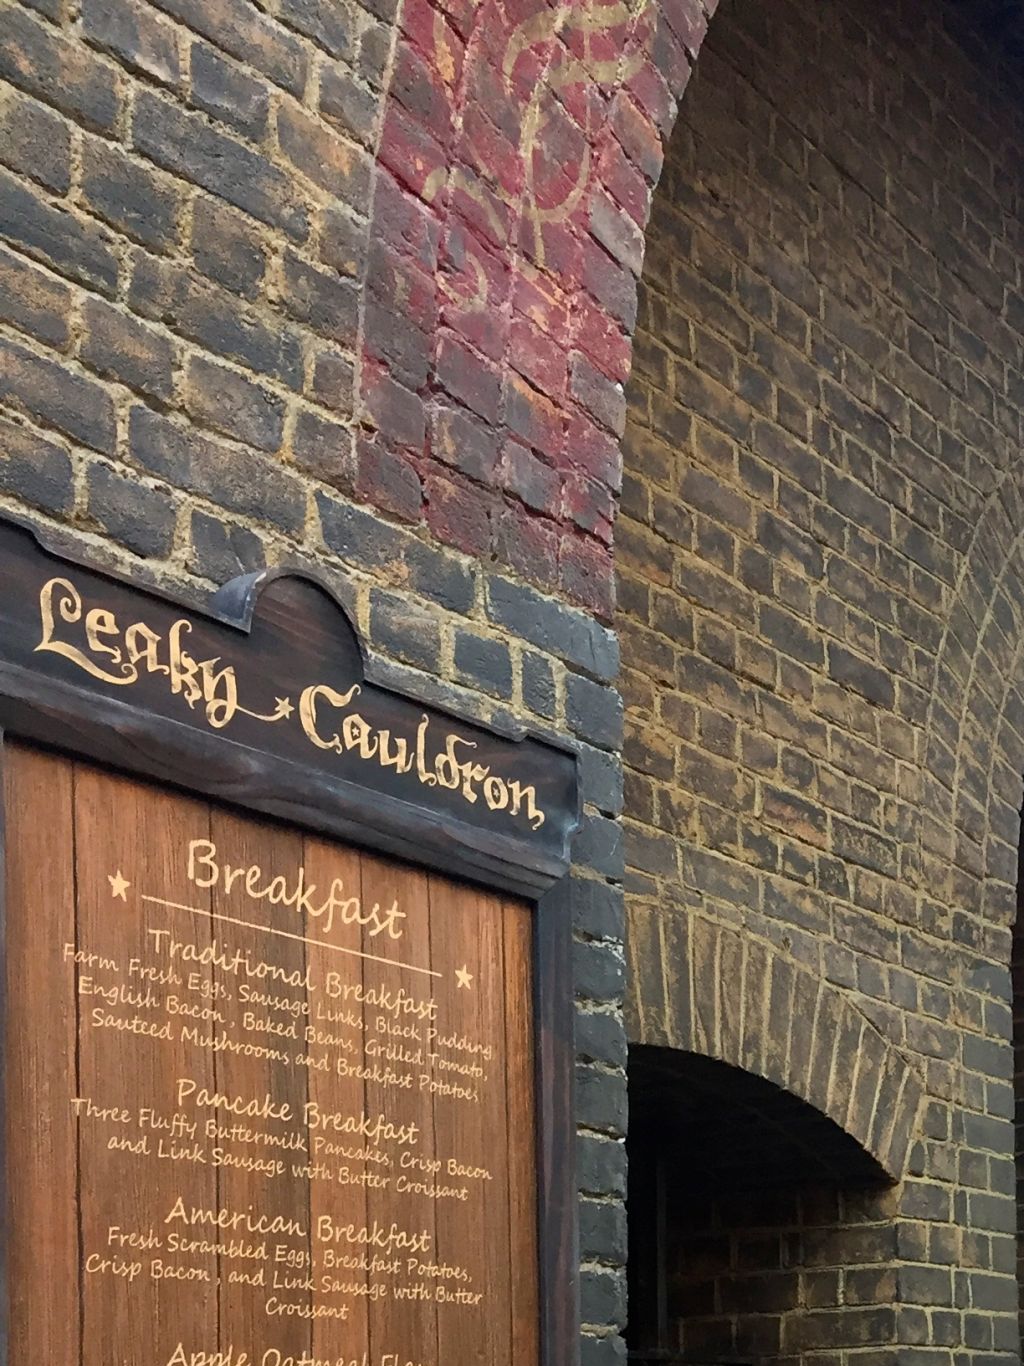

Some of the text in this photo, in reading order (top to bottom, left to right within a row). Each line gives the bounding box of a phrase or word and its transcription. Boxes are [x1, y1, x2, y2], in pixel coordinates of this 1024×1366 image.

[34, 577, 545, 830] Leaky Cauldron
[186, 839, 406, 939] Breakfast
[63, 943, 492, 1060] Farm Fresh Eggs, Sausage Links, Black Pudding
[149, 929, 438, 1020] Traditional Breakfast
[79, 977, 159, 1009] English
[243, 1013, 298, 1040] Baked
[305, 1026, 359, 1054] Beans,
[365, 1039, 424, 1067] Grilled
[428, 1054, 488, 1082] Tomato,
[92, 1009, 479, 1101] Sauteed Mushrooms and Breakfast Potatoes
[70, 1098, 493, 1181] Three Fluffy Buttermilk Pancakes, Crisp Bacon
[177, 1079, 420, 1146] Pancake Breakfast
[108, 1134, 469, 1201] and Link Sausage with Butter Croissant
[108, 1227, 472, 1282] Fresh Scrambled Eggs, Breakfast Potatoes,
[164, 1197, 431, 1253] American Breakfast
[86, 1255, 142, 1282] Crisp
[229, 1269, 267, 1287] and
[273, 1270, 316, 1291] Link
[322, 1277, 387, 1300] Sausage
[394, 1281, 431, 1300] with
[436, 1287, 483, 1306] Butter
[266, 1300, 349, 1320] Croissant
